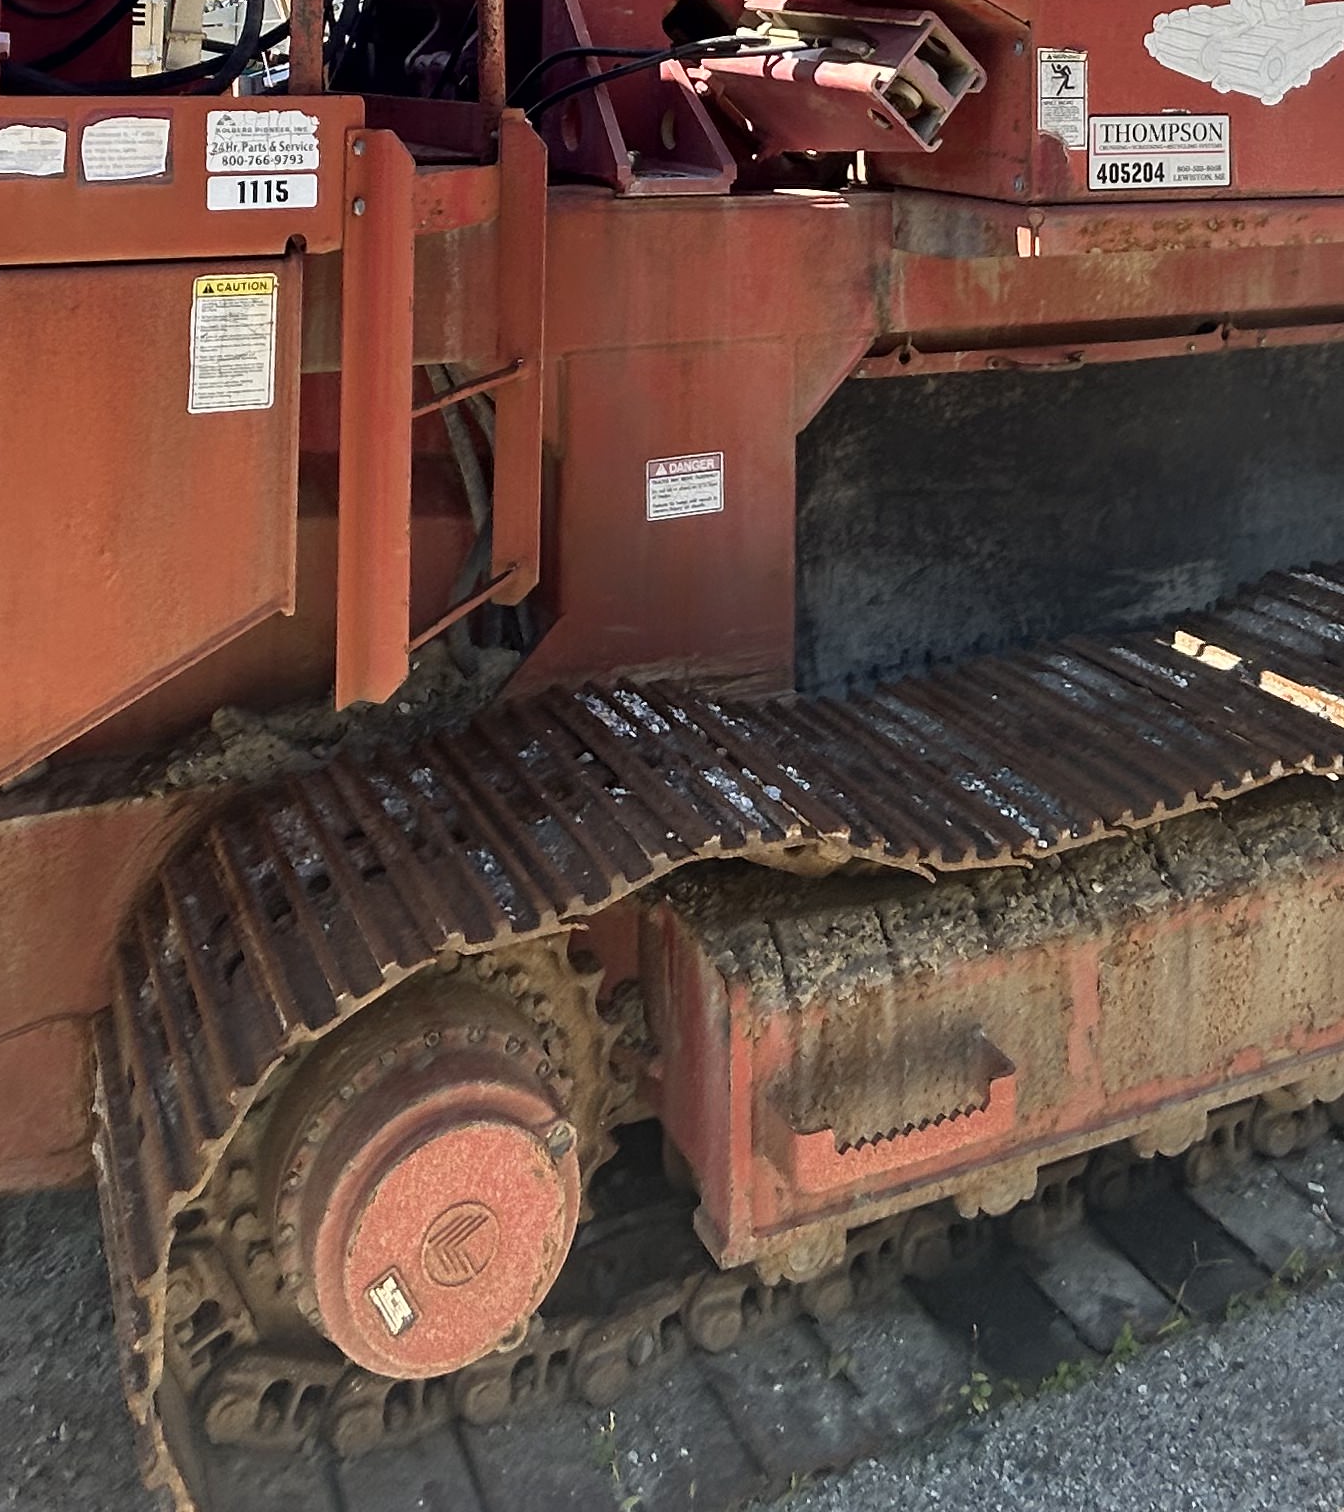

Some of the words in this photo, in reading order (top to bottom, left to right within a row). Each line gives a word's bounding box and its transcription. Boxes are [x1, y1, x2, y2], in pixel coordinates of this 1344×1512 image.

[1099, 122, 1223, 143] THOMPSON
[242, 141, 267, 153] Parts
[269, 141, 277, 152] &
[279, 140, 314, 152] Service
[222, 154, 304, 166] 800-766-9793
[1097, 162, 1165, 184] 405204
[237, 180, 289, 203] 1115
[216, 281, 267, 292] CAUTION
[668, 458, 715, 473] DANGER
